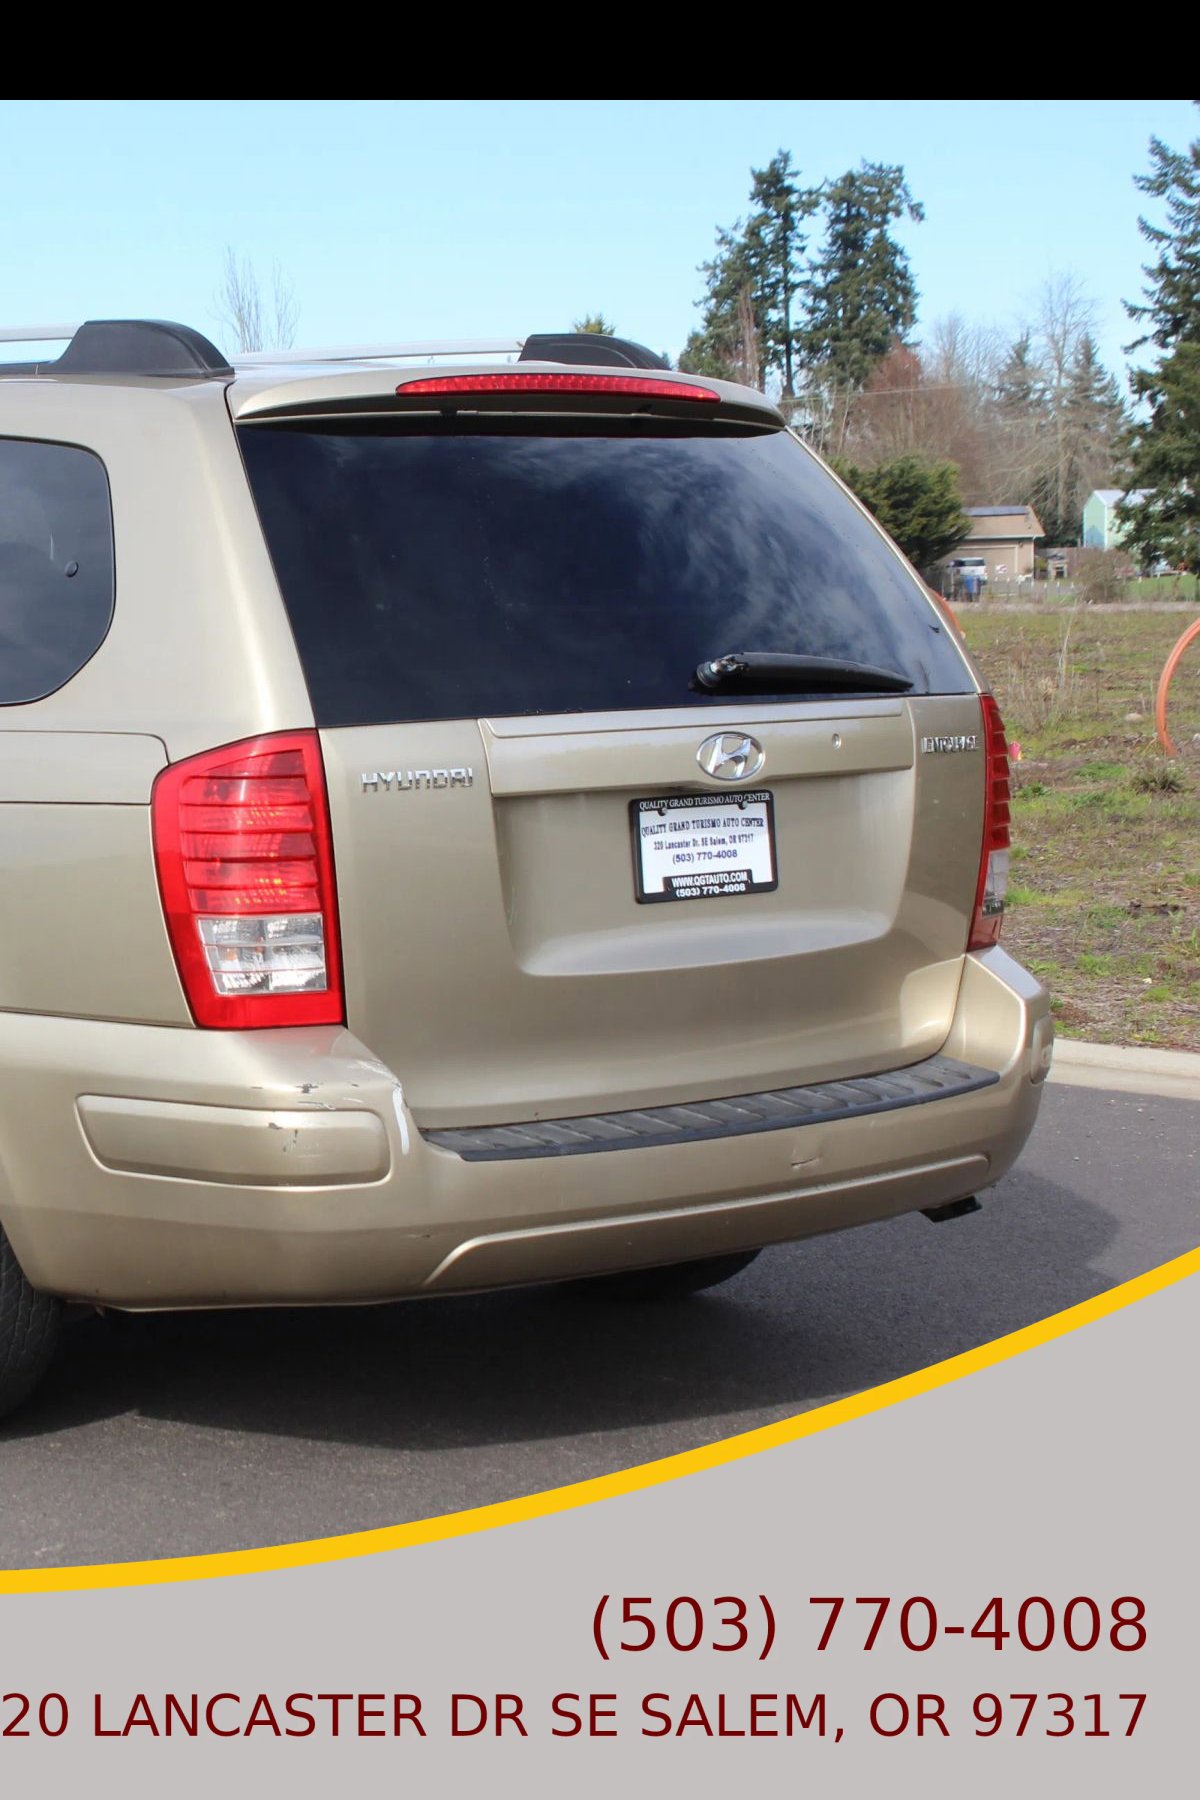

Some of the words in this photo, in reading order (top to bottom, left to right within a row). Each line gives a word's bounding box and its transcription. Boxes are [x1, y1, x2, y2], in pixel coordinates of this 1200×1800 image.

[361, 768, 474, 793] HYUNDAI
[639, 800, 668, 810] QUALITY
[669, 797, 694, 807] GRAND
[694, 795, 725, 805] TURISMO
[725, 794, 744, 803] AUTO
[744, 792, 771, 802] CENTER
[641, 823, 667, 837] QUALITY
[669, 821, 690, 832] GRAND
[692, 818, 721, 829] TURISMO
[723, 817, 739, 828] AUTO
[741, 817, 764, 827] CENTER
[701, 837, 709, 846] SE
[672, 852, 695, 865] (503)
[697, 849, 738, 861] 770-4008
[671, 871, 748, 889] WWW.QGTAUTO.COM
[675, 886, 701, 898] (503)
[702, 883, 746, 896] 770-4008
